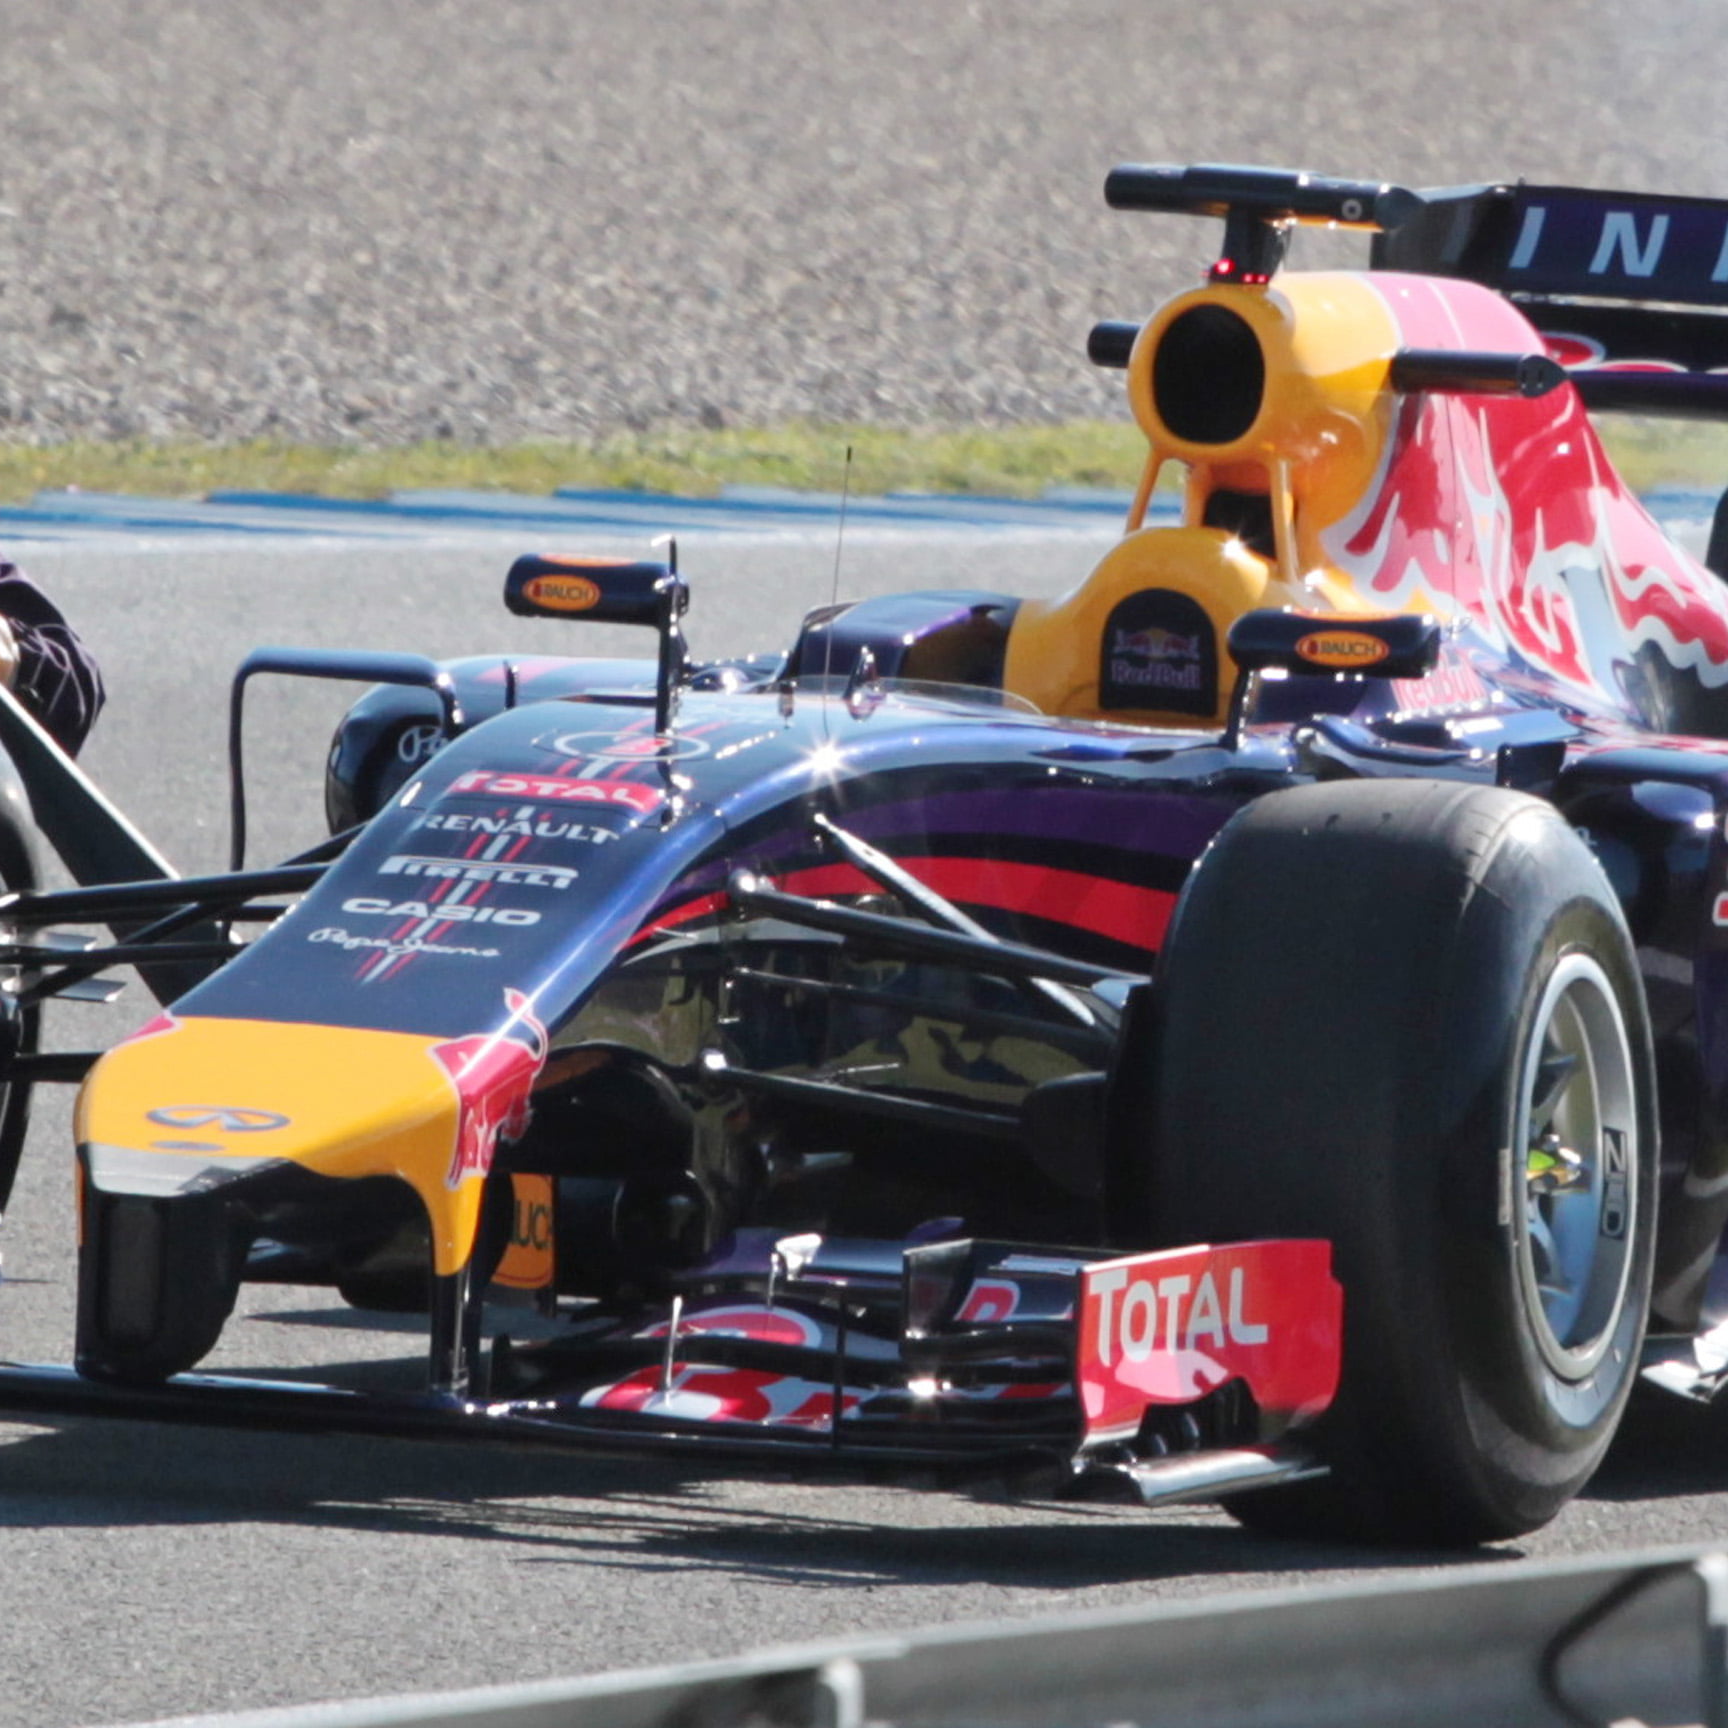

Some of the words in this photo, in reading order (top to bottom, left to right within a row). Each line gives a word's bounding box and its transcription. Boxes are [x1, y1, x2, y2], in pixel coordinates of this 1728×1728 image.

[1319, 639, 1375, 657] RAUCH
[454, 773, 645, 809] TOTAL
[420, 813, 620, 846] RENAULT
[377, 855, 579, 890] PIRELLI
[341, 897, 542, 927] CASIO
[306, 926, 392, 951] Pepe
[387, 936, 501, 958] Jeans
[1088, 1267, 1269, 1368] TOTAL
